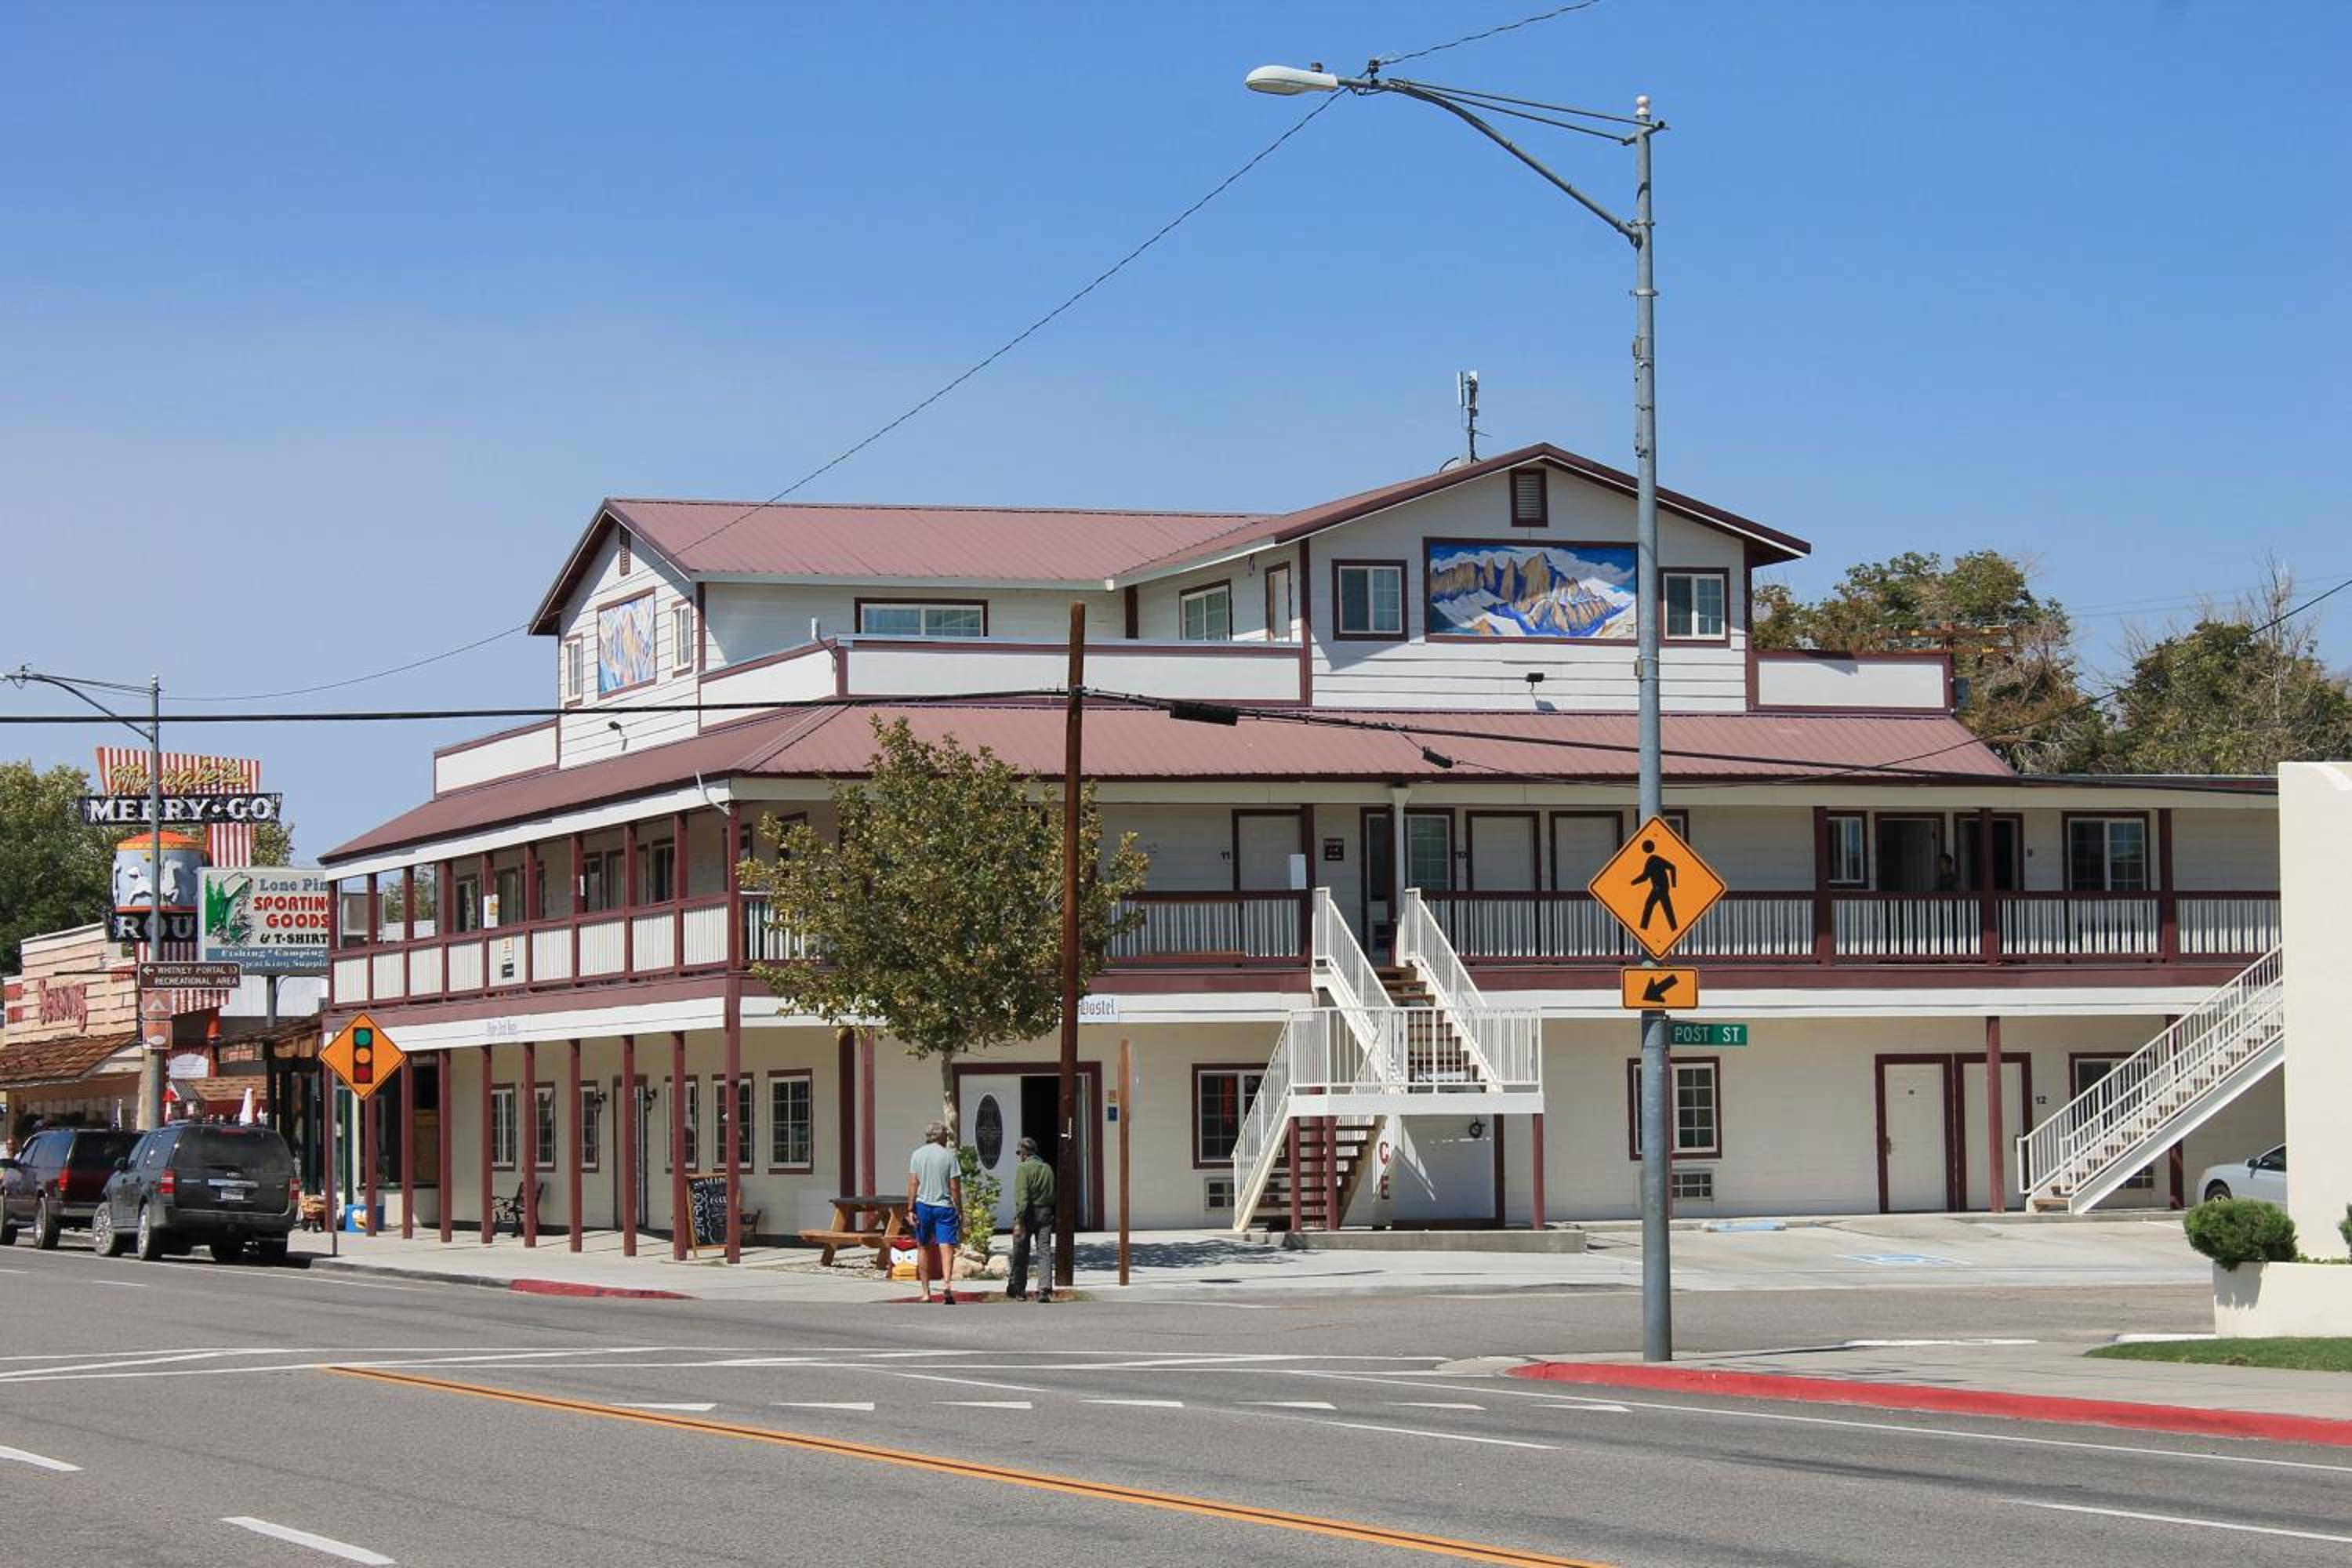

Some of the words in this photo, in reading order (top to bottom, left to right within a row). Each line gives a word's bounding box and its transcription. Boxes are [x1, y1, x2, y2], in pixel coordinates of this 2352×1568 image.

[260, 879, 297, 891] Lone
[303, 878, 328, 891] Pin
[253, 896, 328, 911] SPORTIN
[114, 916, 194, 938] ROU
[260, 933, 270, 944] &
[274, 934, 328, 944] T-SHIRT
[155, 977, 212, 985] RECREATIONAL
[1675, 1026, 1709, 1041] POST
[1722, 1026, 1740, 1042] ST
